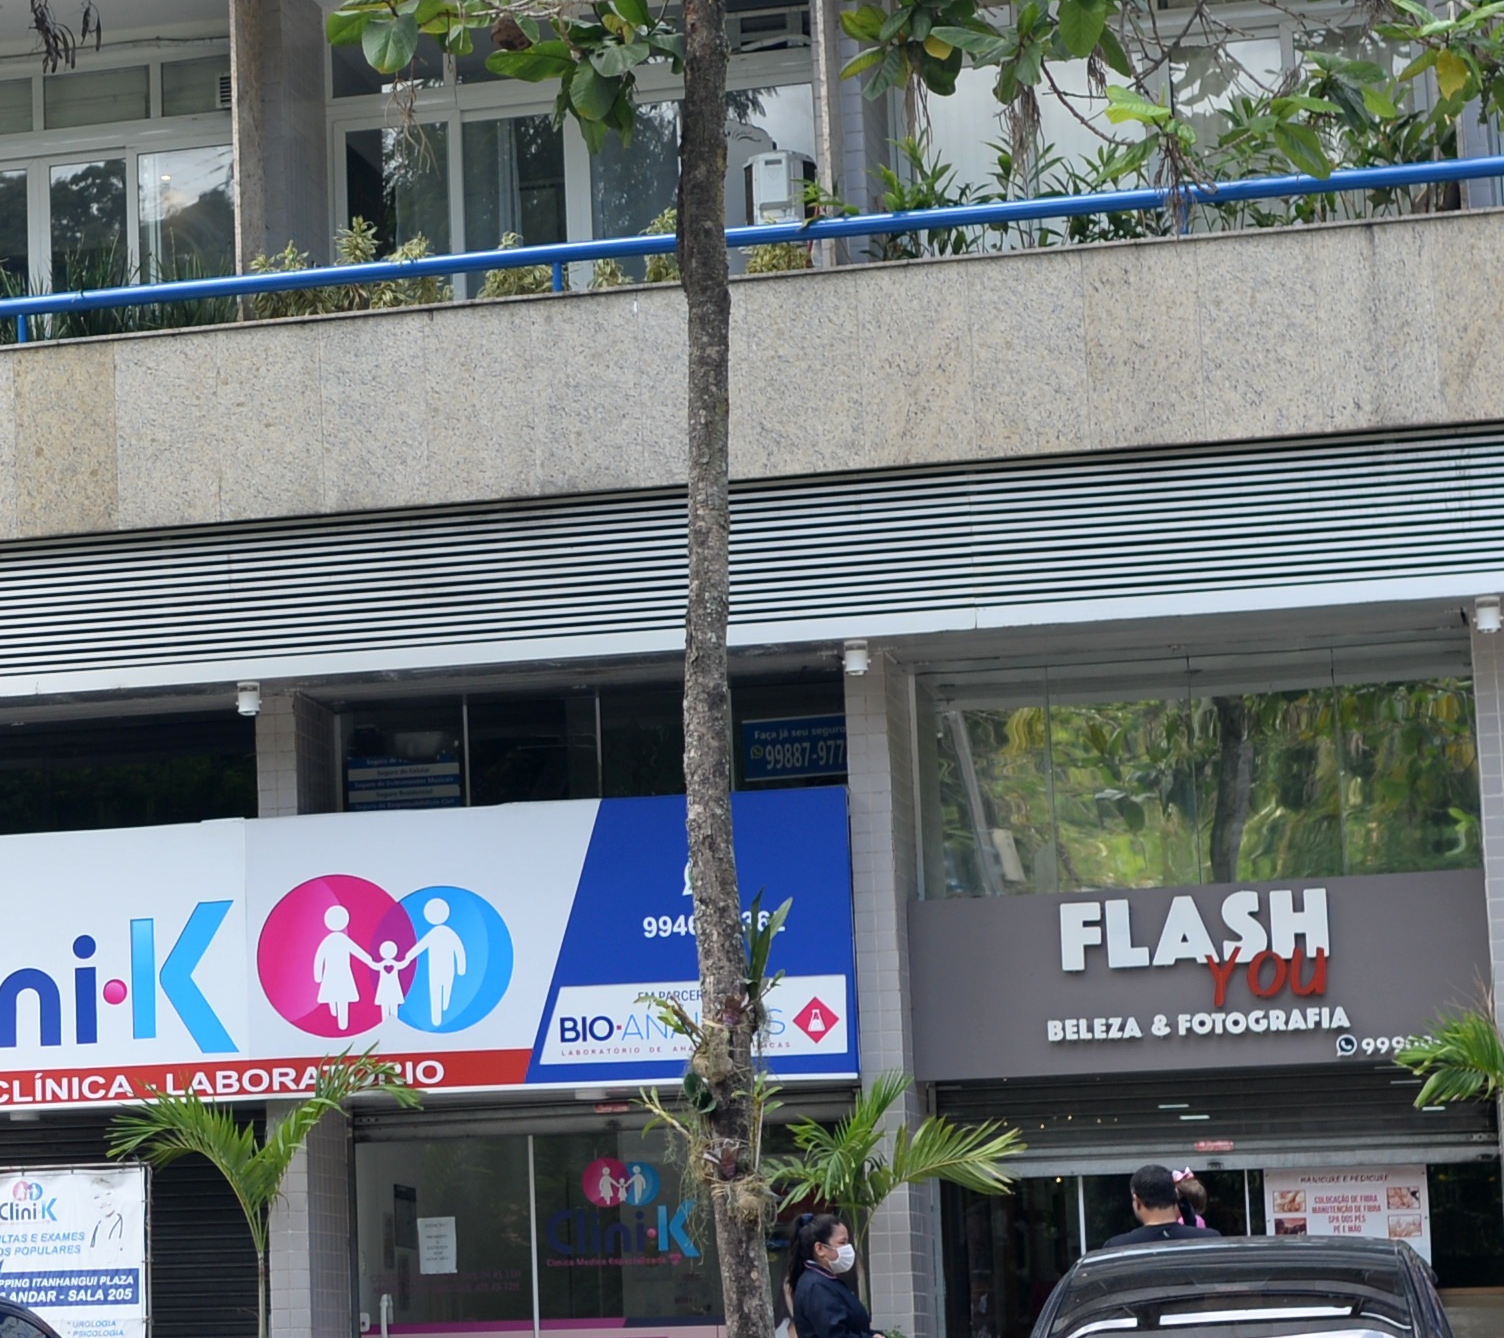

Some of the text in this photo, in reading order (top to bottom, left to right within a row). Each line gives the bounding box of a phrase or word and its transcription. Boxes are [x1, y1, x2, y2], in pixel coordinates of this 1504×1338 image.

[754, 728, 777, 740] Faça
[779, 727, 789, 740] já
[792, 728, 808, 737] seu
[765, 740, 844, 770] 99887-977
[1059, 887, 1330, 972] FLASH
[1047, 1006, 1352, 1042] BELEZA & FOTOGRAFIA
[31, 1233, 38, 1243] E
[41, 1231, 86, 1242] EXAMES
[14, 1245, 82, 1257] POPULARES
[31, 1275, 98, 1288] ITANHANGUI
[99, 1274, 134, 1286] PLAZA
[8, 1290, 56, 1303] ANDAR
[67, 1289, 105, 1302] SALA
[107, 1288, 133, 1301] 205
